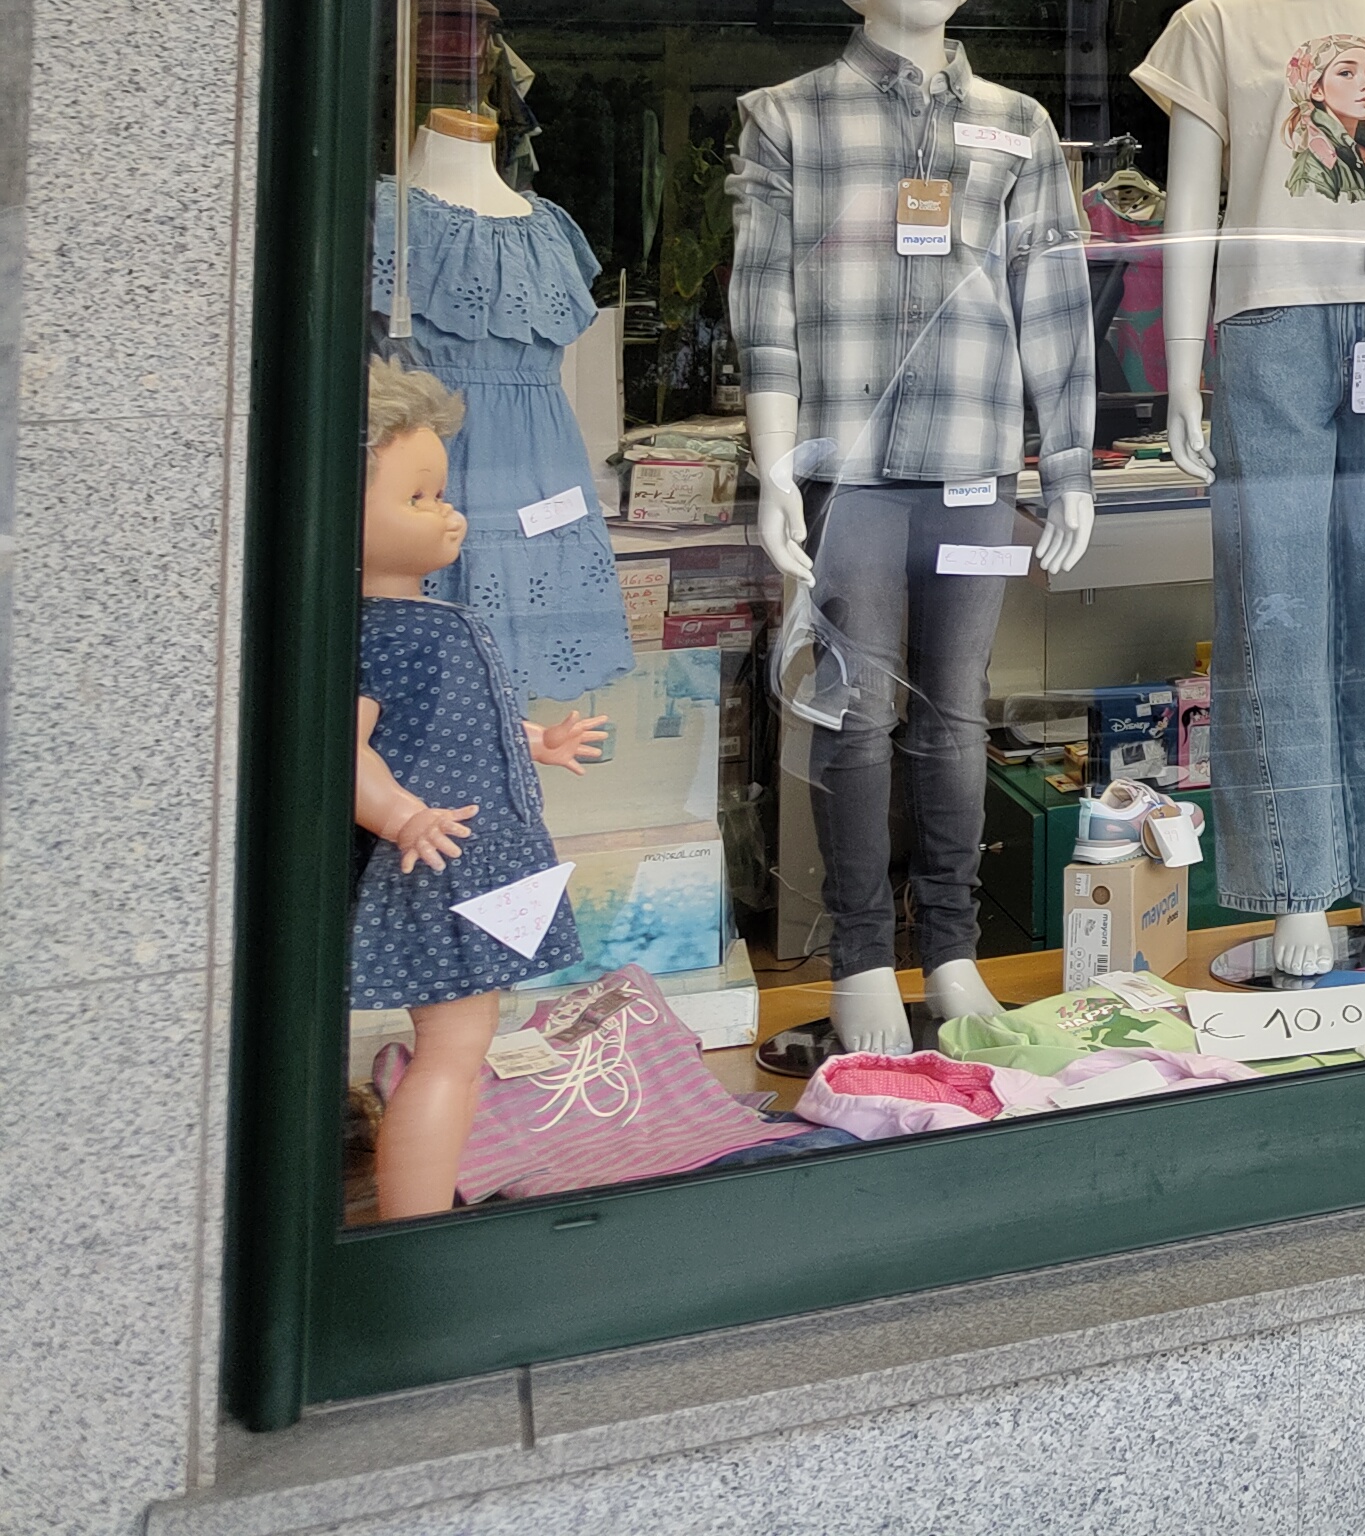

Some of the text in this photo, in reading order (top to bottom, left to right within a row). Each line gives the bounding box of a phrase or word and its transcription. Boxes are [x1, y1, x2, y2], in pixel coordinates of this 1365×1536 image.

[903, 235, 947, 245] mayoral
[948, 485, 991, 496] mayoral
[1109, 718, 1150, 734] Disney
[643, 848, 711, 862] mayoral.com
[1141, 883, 1179, 931] mayoral
[1101, 914, 1109, 947] mayoral
[1199, 1012, 1246, 1039] €
